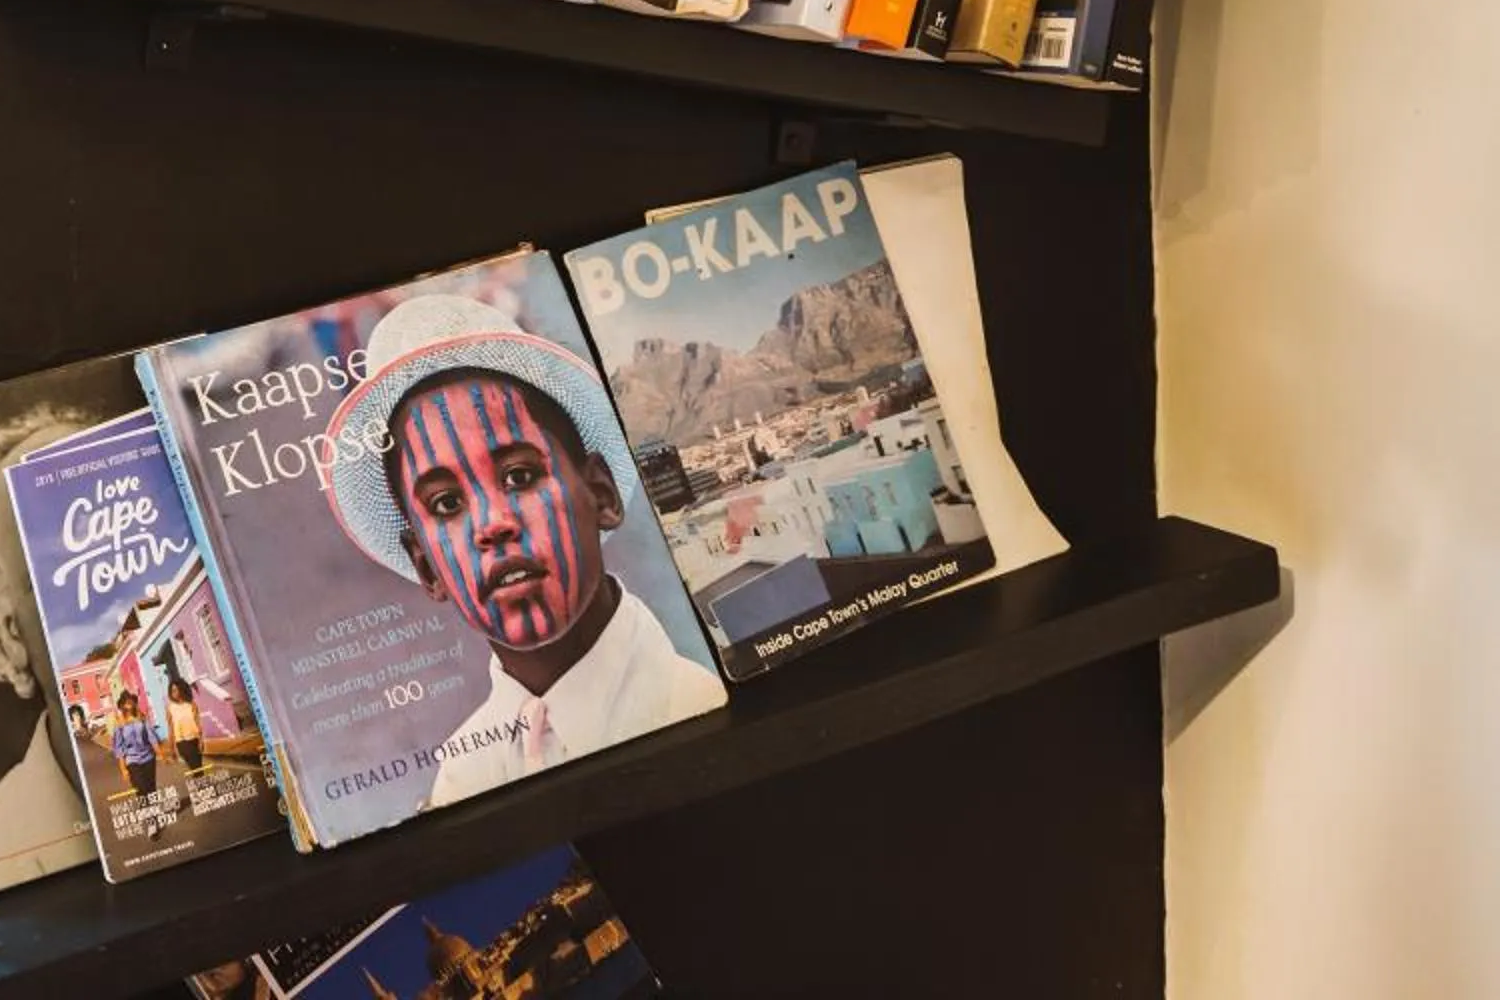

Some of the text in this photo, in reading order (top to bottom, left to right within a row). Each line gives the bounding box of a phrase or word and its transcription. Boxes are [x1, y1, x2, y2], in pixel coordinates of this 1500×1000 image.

[575, 177, 858, 315] BO-KAAP
[186, 350, 368, 425] Kaapse
[96, 475, 142, 503] love
[211, 418, 395, 497] Klopse
[62, 496, 159, 552] Cape
[52, 531, 189, 611] Town
[754, 559, 960, 658] Inside Cape Town's Malay Quarter
[290, 615, 446, 675] MINSTREL CARNIVAL
[315, 602, 406, 643] CAPE TOWN
[311, 712, 351, 734] more
[384, 680, 424, 709] 100
[324, 713, 531, 801] GERALD HOBERMAN
